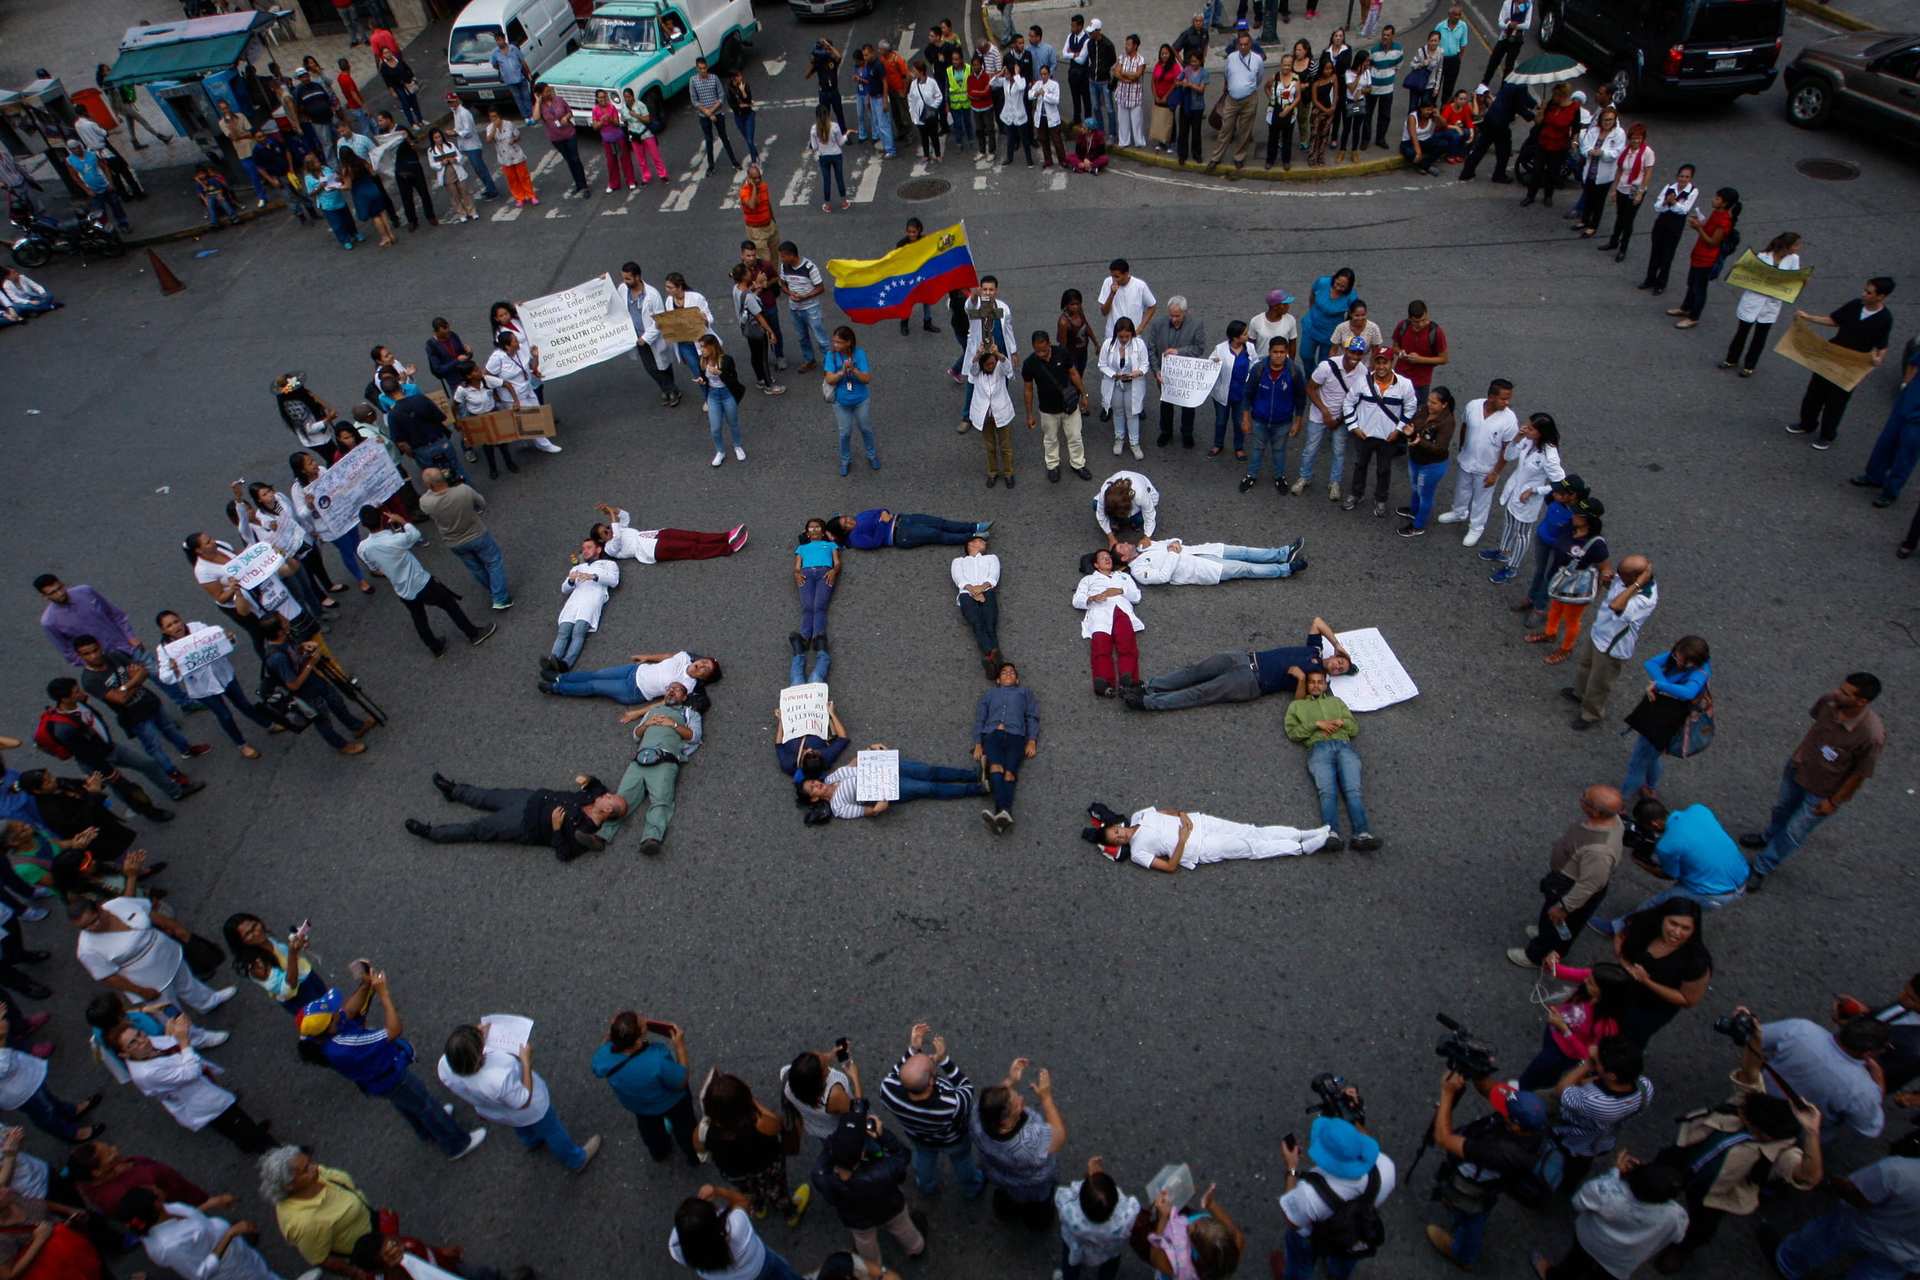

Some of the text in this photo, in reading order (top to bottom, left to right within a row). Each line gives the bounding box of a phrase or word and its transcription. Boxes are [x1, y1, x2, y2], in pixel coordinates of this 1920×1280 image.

[542, 324, 630, 363] por sueldos de HAMBRE
